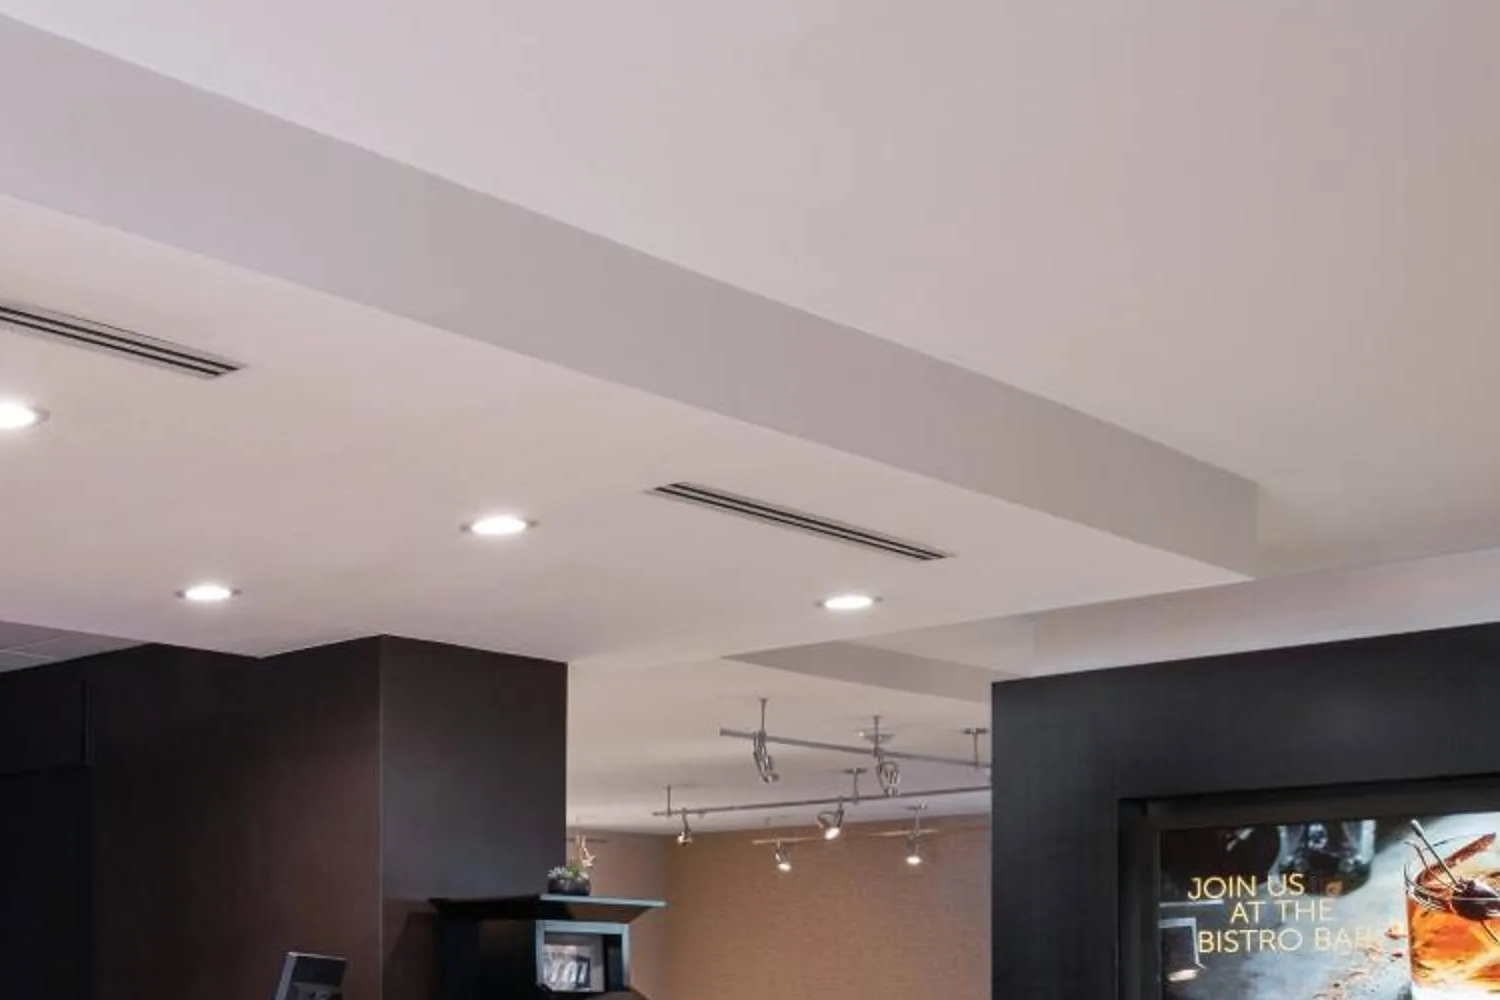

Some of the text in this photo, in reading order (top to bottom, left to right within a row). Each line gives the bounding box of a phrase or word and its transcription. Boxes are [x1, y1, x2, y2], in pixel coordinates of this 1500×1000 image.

[1187, 873, 1305, 900] JOIN US
[1230, 899, 1334, 924] AT THE
[1199, 928, 1303, 954] BISTRO
